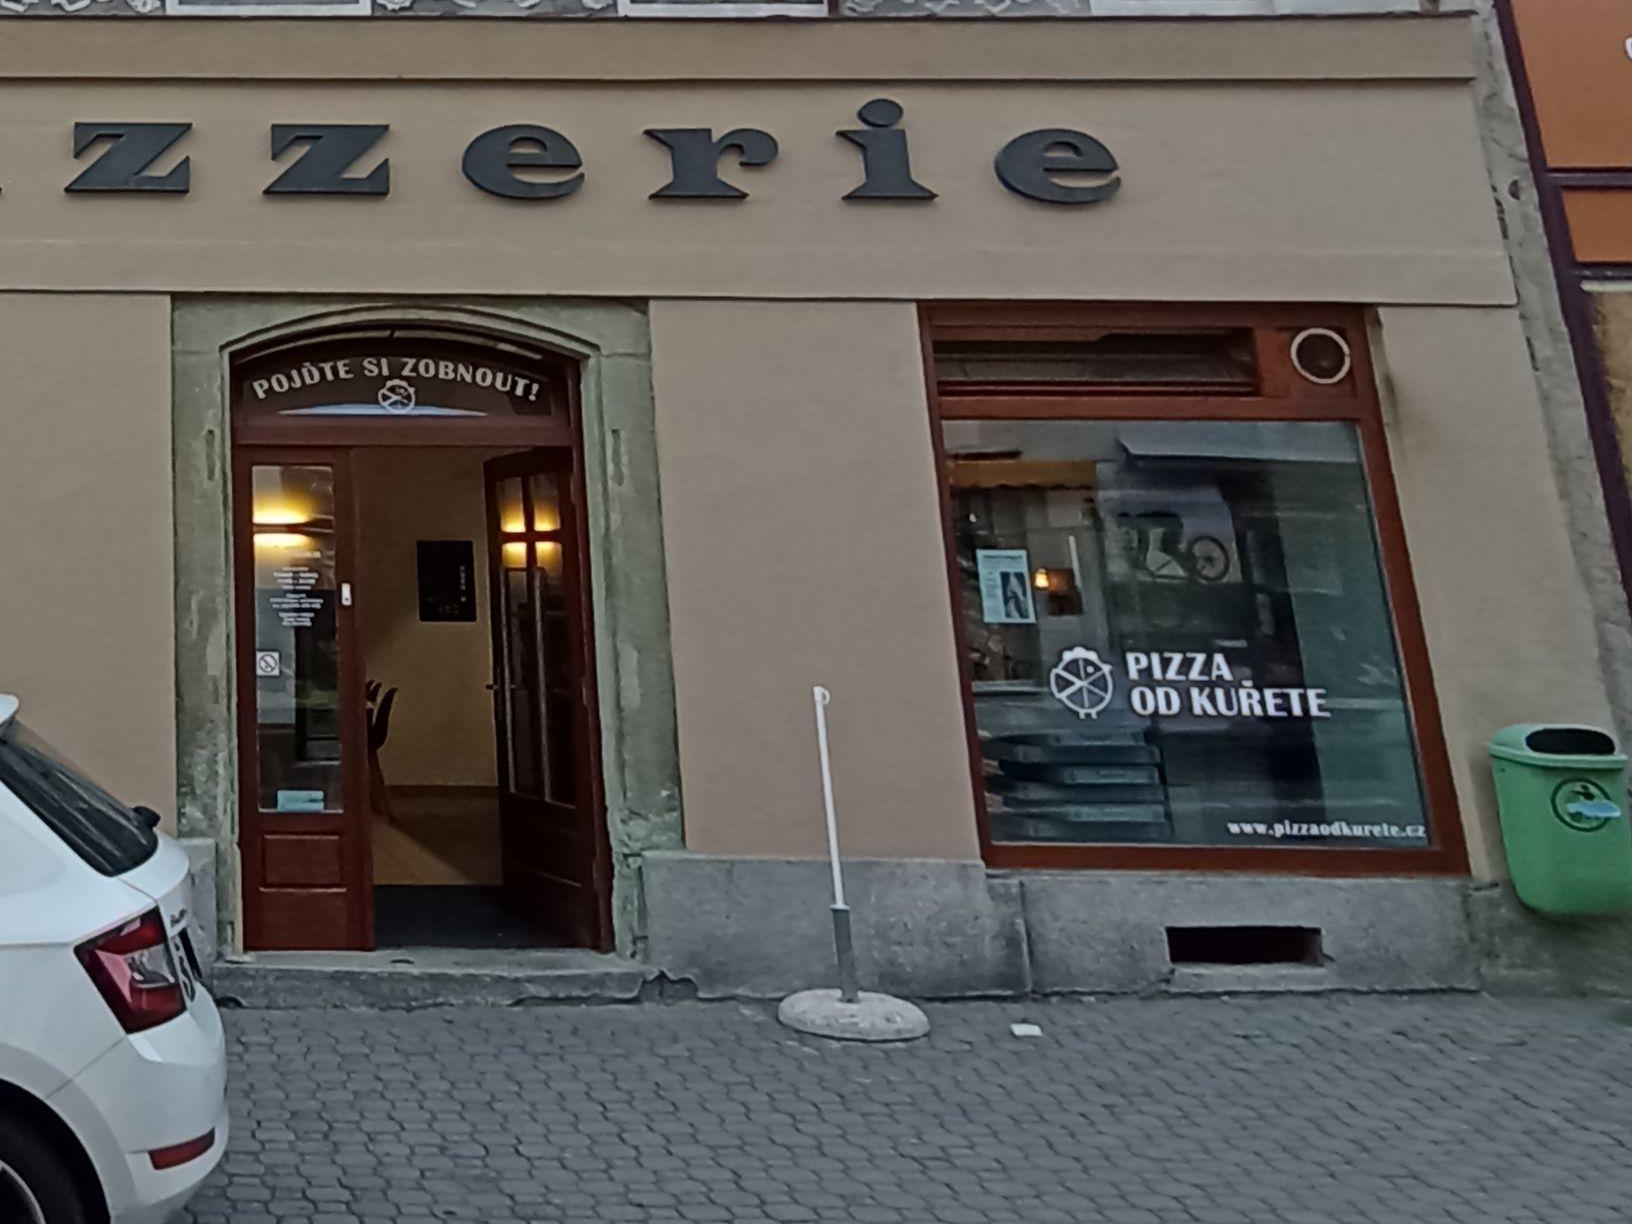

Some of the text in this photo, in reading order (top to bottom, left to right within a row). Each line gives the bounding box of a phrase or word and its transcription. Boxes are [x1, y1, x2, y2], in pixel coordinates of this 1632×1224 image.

[252, 357, 540, 401] POJĎTE SI ZOBNOUT!
[1125, 651, 1234, 681] PIZZA
[1131, 679, 1332, 718] OD KUŘETE
[1227, 819, 1426, 838] www.pizzaodkurete.cz
